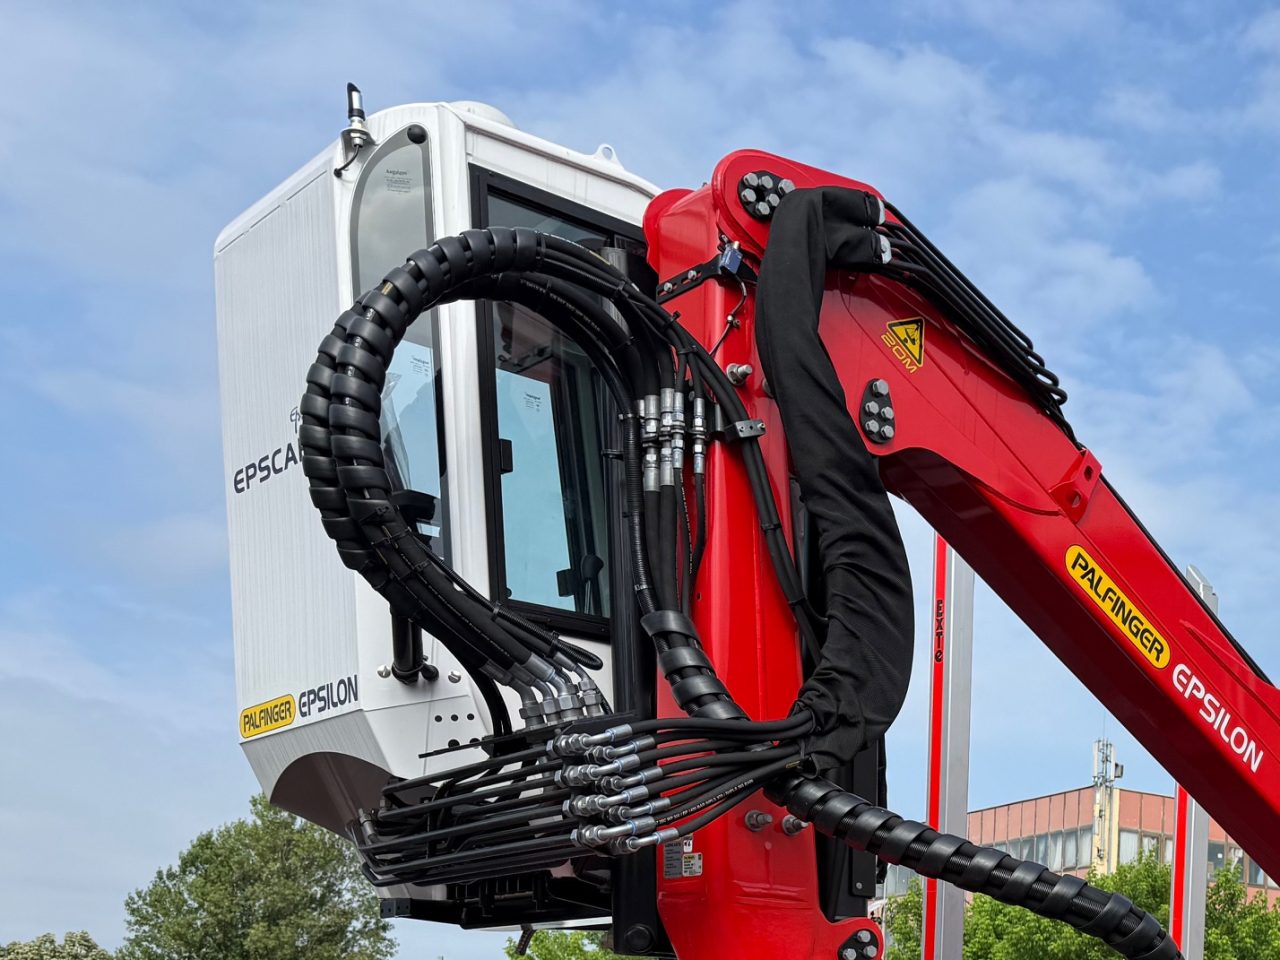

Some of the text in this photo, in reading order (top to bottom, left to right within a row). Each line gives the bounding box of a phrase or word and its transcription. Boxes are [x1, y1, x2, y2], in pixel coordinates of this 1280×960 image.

[233, 442, 303, 494] EPSCA
[1070, 552, 1265, 774] PALFINGER EPSILON
[242, 674, 359, 734] PALFINGER EPSILON
